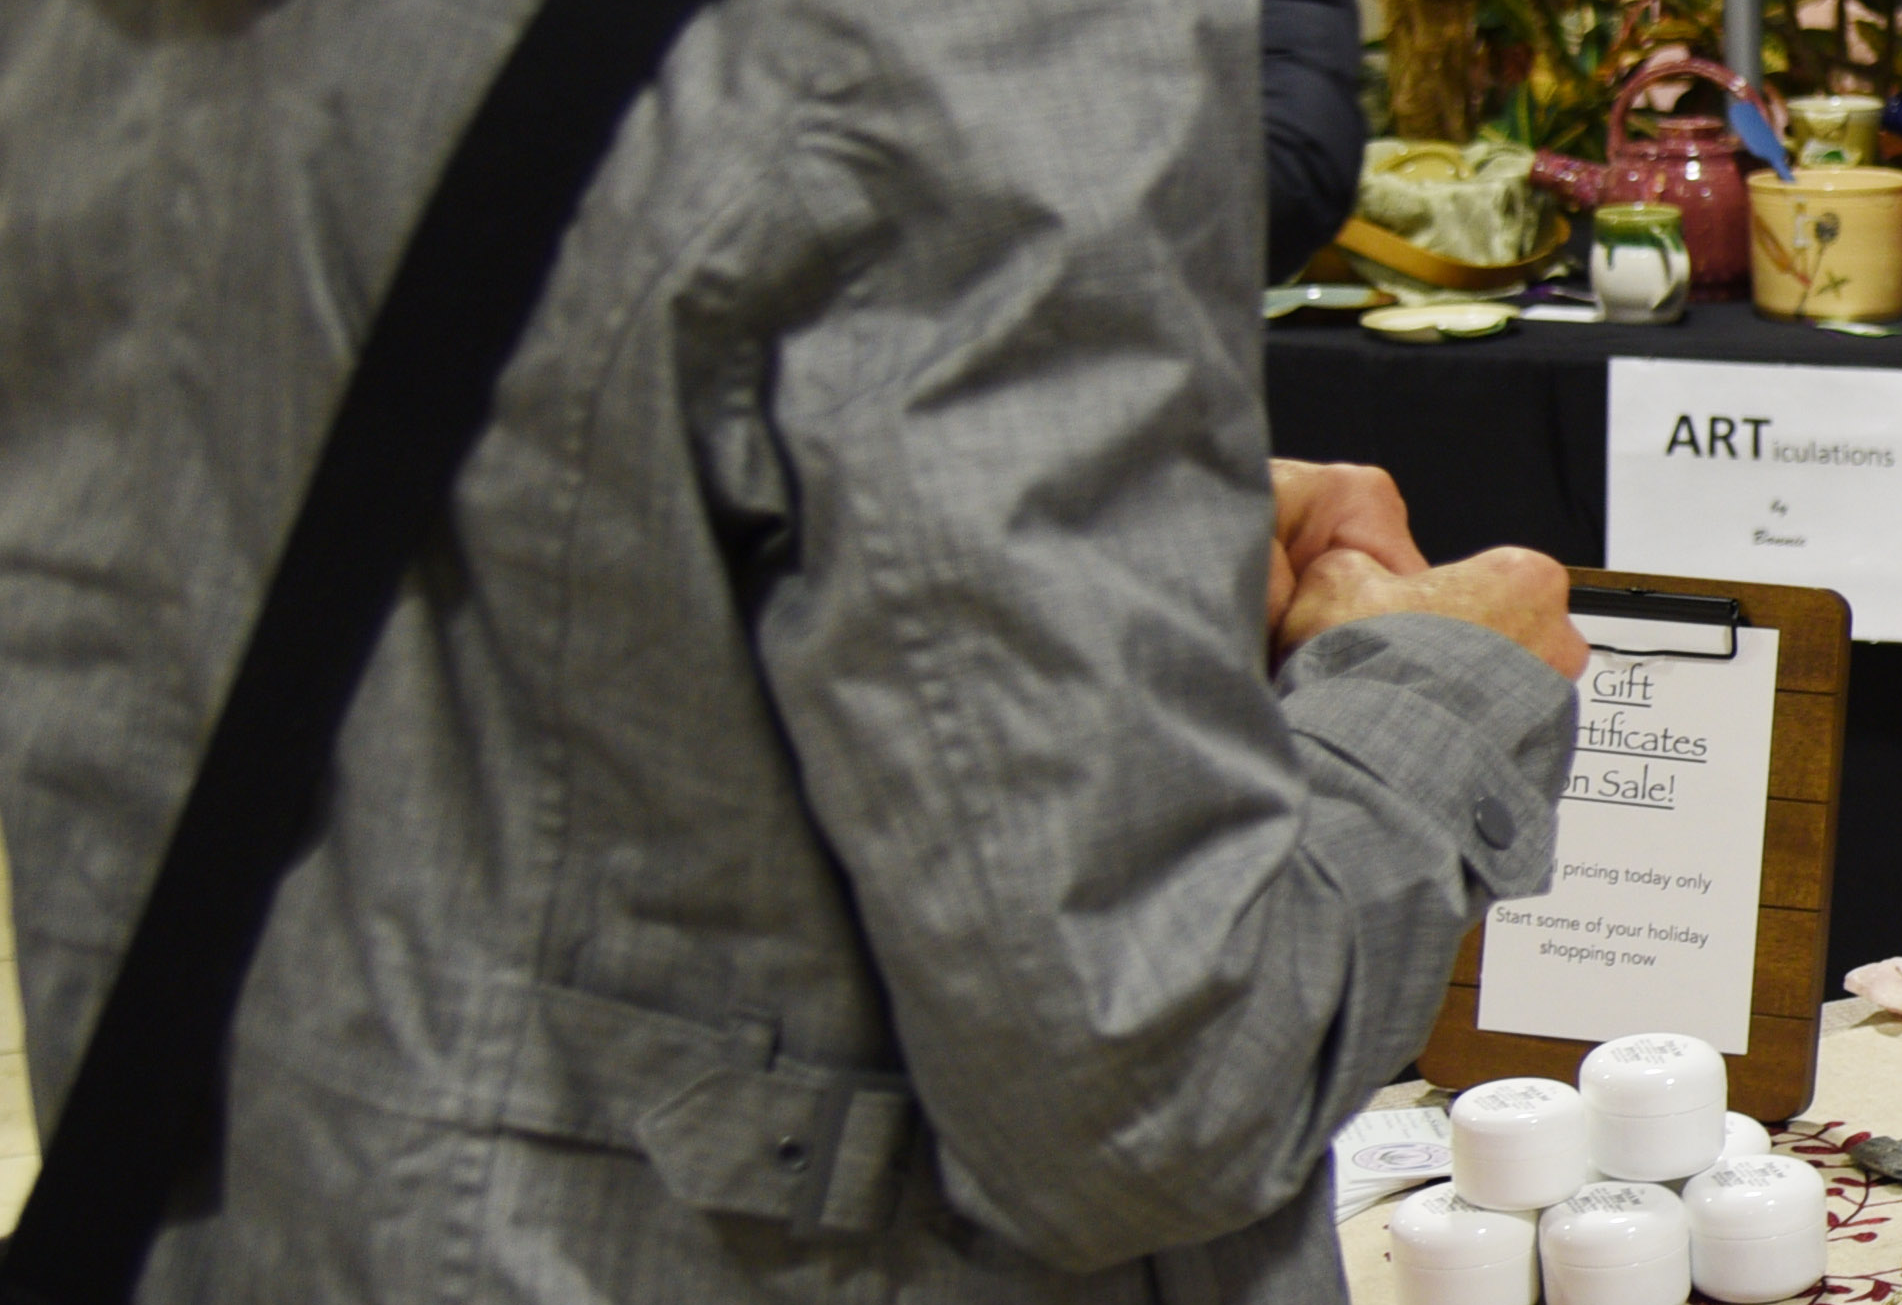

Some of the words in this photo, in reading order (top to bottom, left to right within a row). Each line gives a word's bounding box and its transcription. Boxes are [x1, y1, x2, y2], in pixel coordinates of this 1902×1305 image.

[1769, 499, 1788, 516] by
[1592, 662, 1655, 703] Gift
[1578, 711, 1708, 757] tificates
[1598, 763, 1676, 804] Sale!
[1563, 863, 1619, 885] pricing
[1624, 868, 1671, 891] today
[1675, 873, 1713, 894] only
[1496, 906, 1532, 927] Start
[1536, 916, 1580, 932] some
[1585, 915, 1602, 933] of
[1605, 921, 1643, 940] your
[1647, 922, 1709, 949] holiday
[1539, 940, 1616, 968] shopping
[1620, 951, 1657, 967] now
